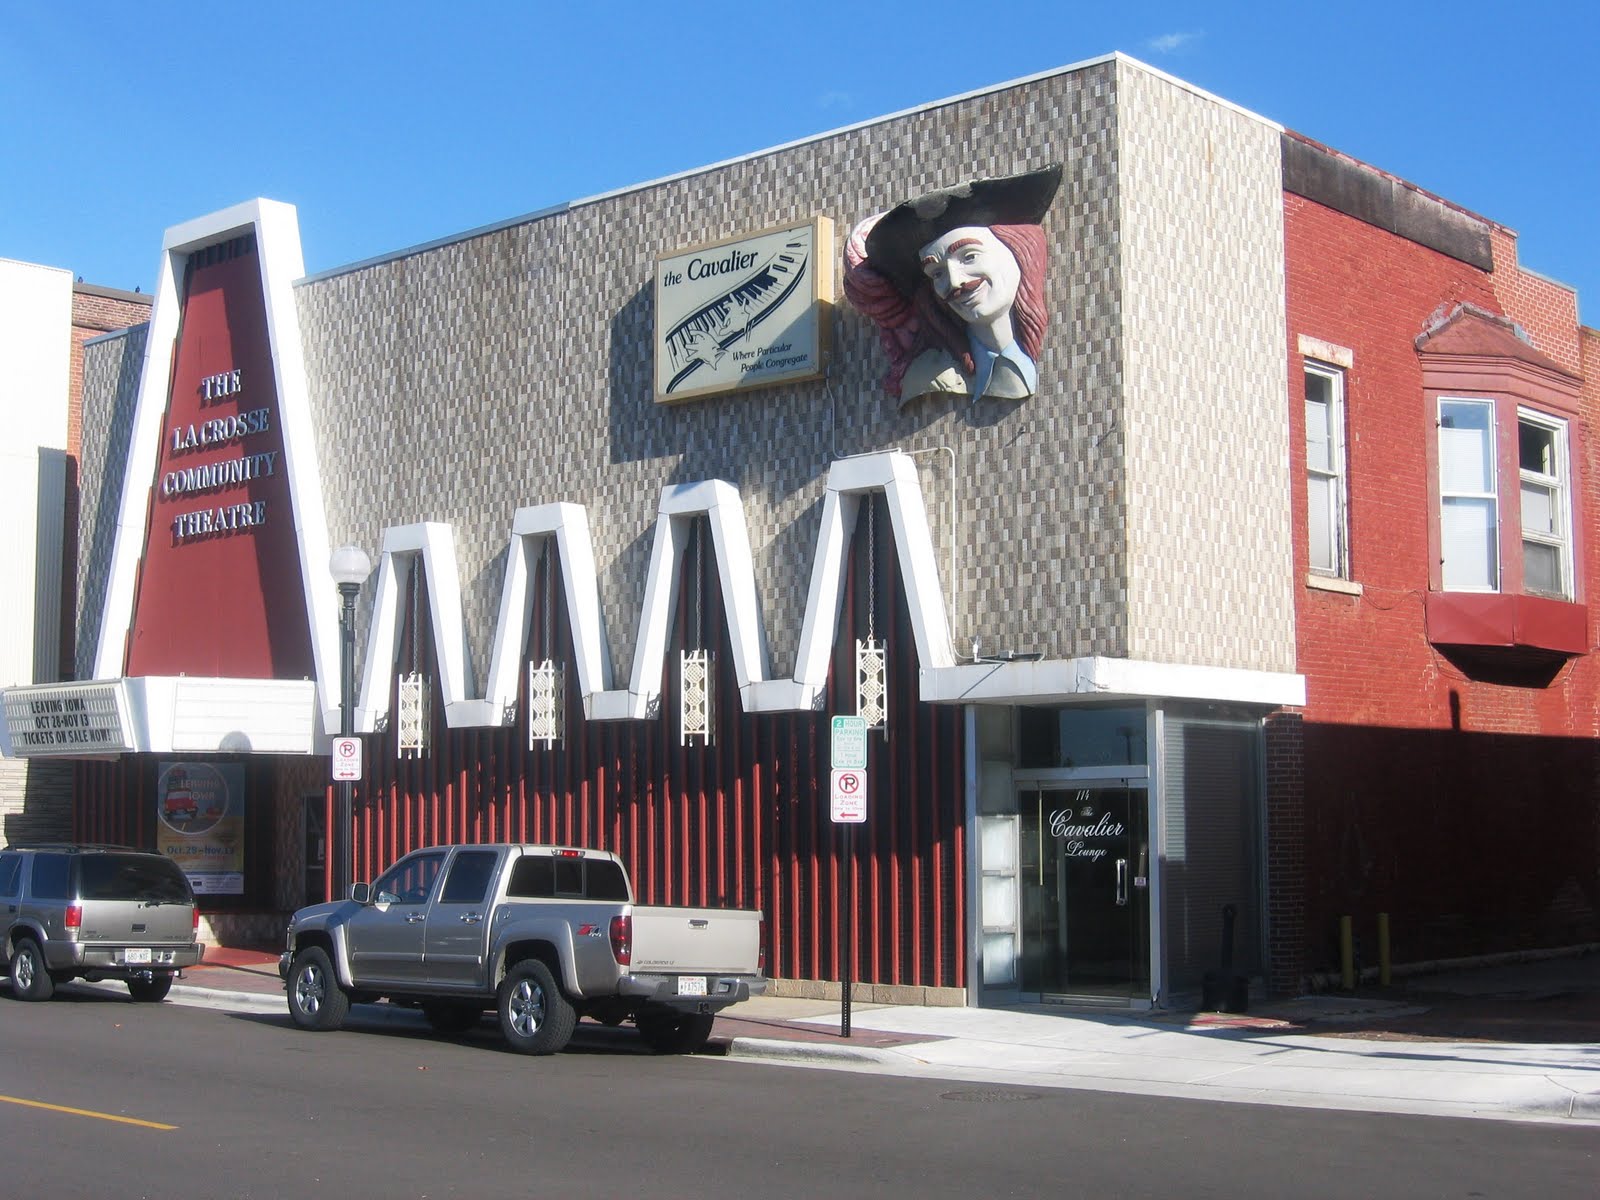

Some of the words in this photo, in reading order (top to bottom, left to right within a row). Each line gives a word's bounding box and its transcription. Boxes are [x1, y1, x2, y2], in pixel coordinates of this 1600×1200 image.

[663, 270, 682, 287] the
[687, 250, 759, 281] Cavalier
[732, 349, 755, 361] Where
[757, 342, 793, 357] Particular
[740, 361, 764, 373] People
[765, 353, 808, 369] Congregate
[202, 369, 241, 400] THE
[163, 451, 278, 496] COMMUNITY
[175, 501, 266, 538] THEATRE
[31, 700, 63, 714] LEAVING
[64, 698, 86, 712] IOWA
[36, 715, 50, 729] OCT
[80, 714, 89, 727] 13
[836, 719, 842, 728] 2
[845, 720, 862, 728] HOUR
[23, 731, 55, 745] TICKETS
[56, 731, 67, 744] ON
[68, 730, 89, 743] SALE
[90, 729, 112, 742] NOW!
[1076, 789, 1090, 801] 114
[1049, 808, 1124, 838] Cavalier
[1065, 840, 1108, 862] Lounge
